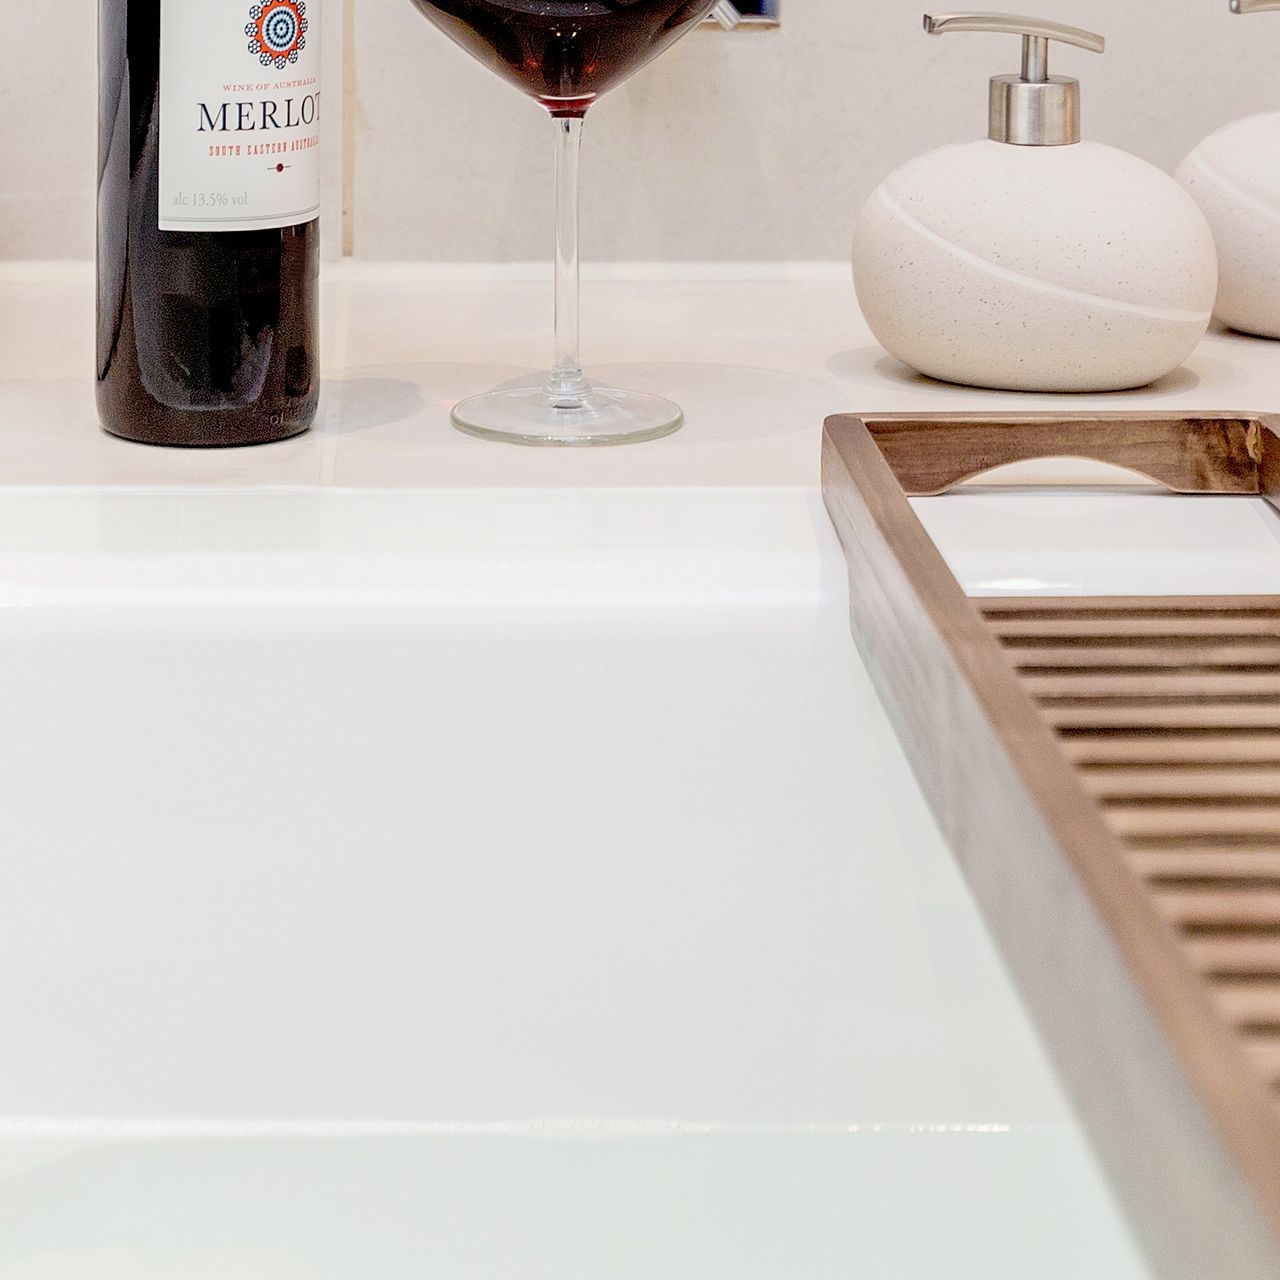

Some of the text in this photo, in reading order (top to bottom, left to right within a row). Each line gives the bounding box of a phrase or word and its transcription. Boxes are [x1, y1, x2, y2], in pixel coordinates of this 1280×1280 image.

[223, 84, 253, 92] WINE
[196, 91, 320, 132] MERLOT
[208, 145, 241, 157] SOUTH
[247, 141, 287, 155] EASTERN
[172, 191, 248, 207] alc 13.5% vol
